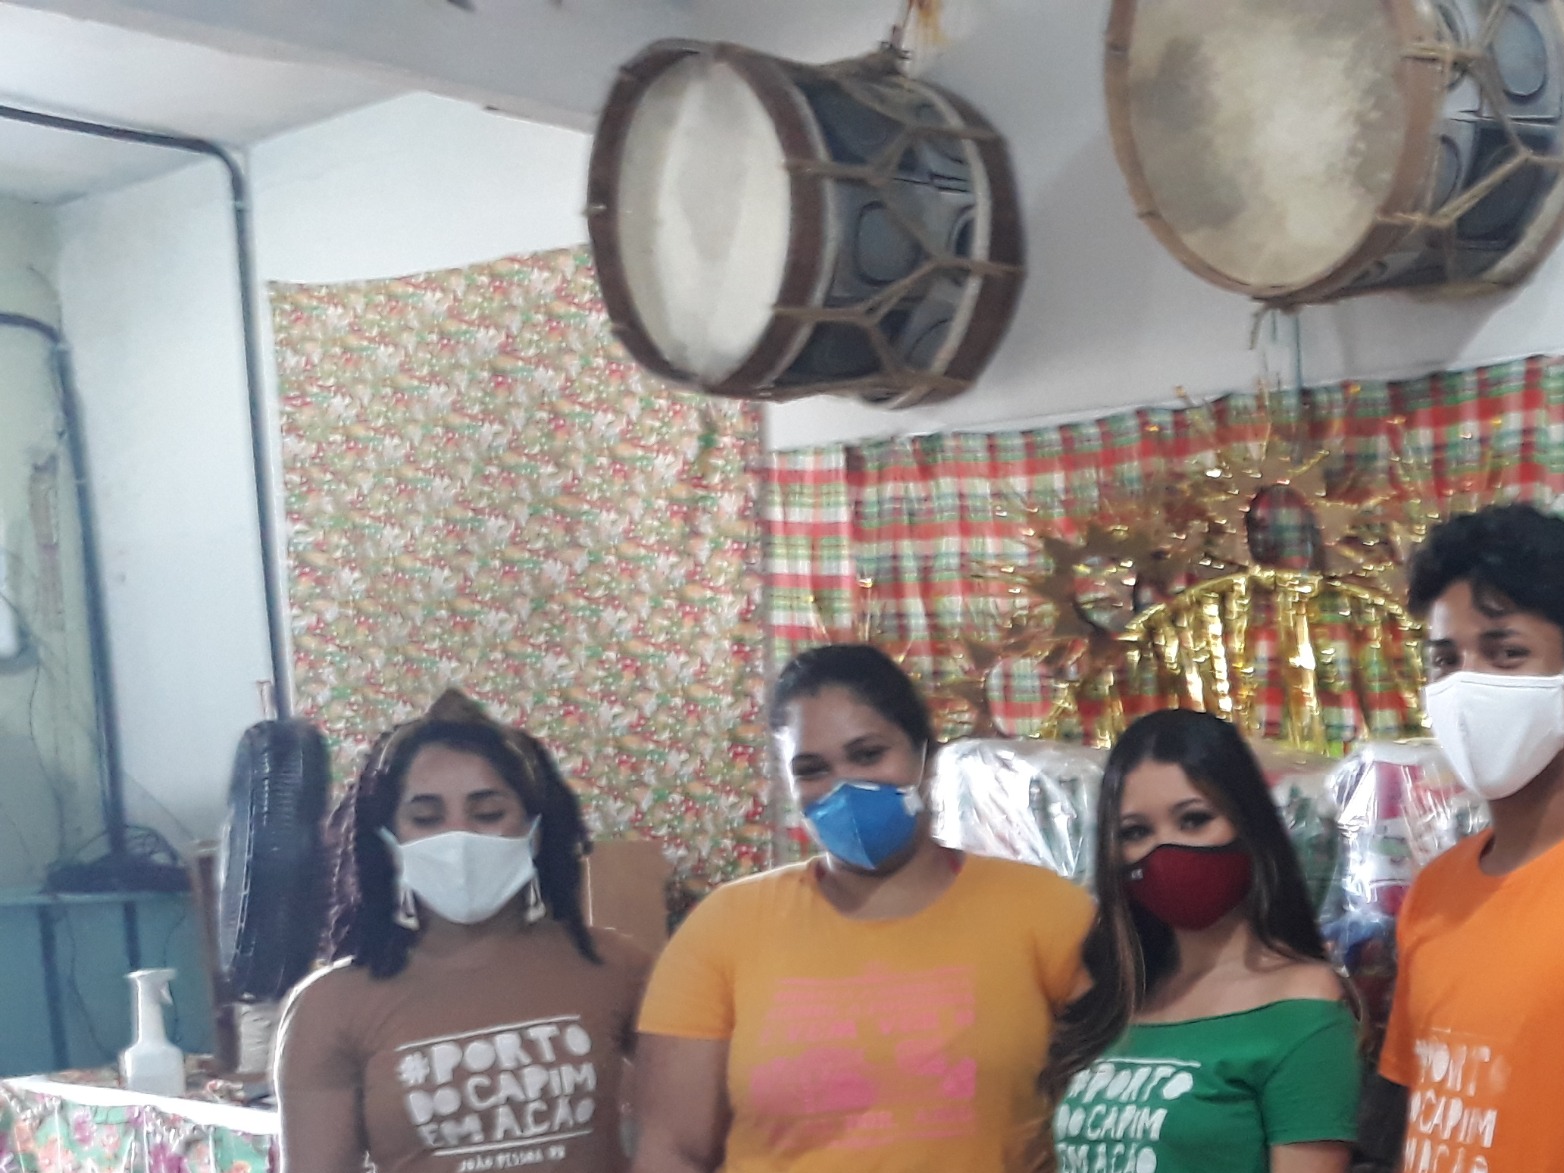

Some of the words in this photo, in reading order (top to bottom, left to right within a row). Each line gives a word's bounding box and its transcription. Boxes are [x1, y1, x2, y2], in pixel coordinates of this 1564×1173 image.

[466, 1062, 598, 1111] CAPIM
[416, 1113, 485, 1149] EM
[1087, 1103, 1168, 1141] CAPIM
[1420, 1088, 1498, 1149] CAPIM
